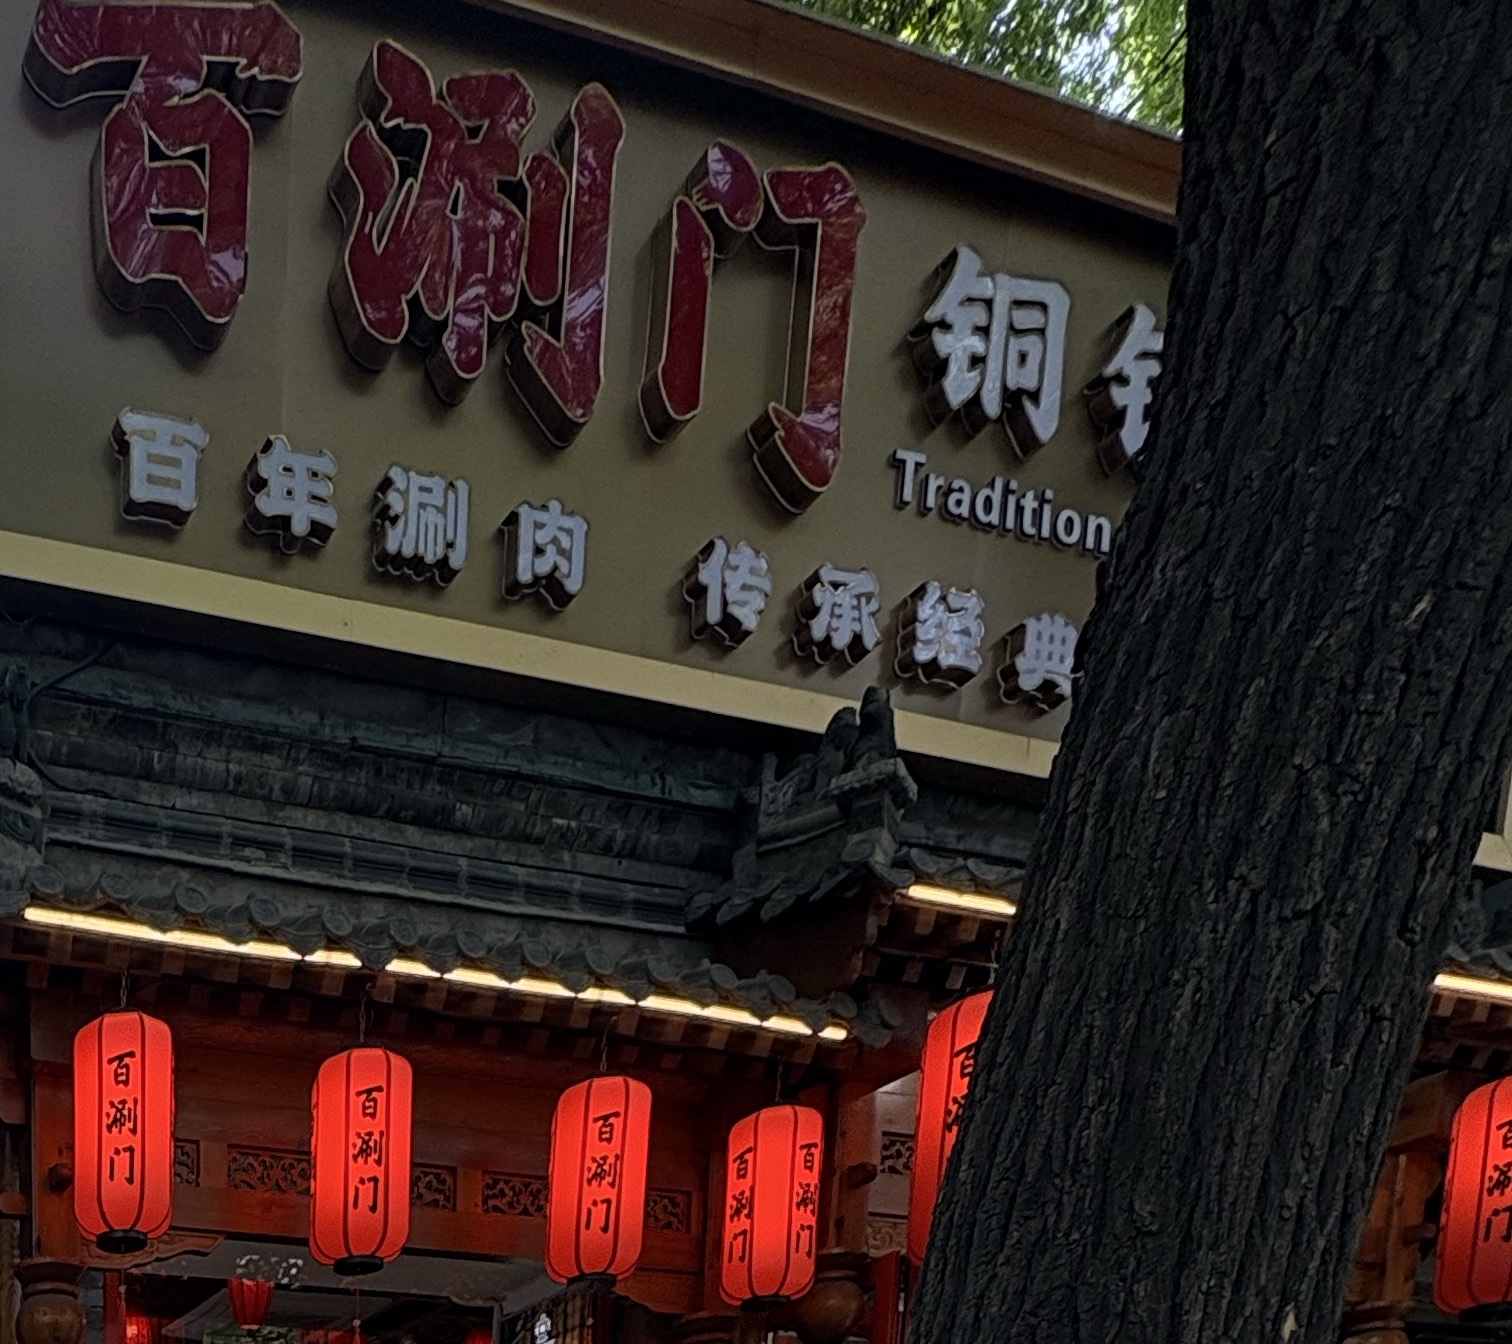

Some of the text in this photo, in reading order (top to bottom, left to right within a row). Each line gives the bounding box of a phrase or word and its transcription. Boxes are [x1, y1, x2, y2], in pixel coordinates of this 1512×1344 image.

[24, 0, 867, 512] 百涮门
[118, 406, 1082, 708] 百年涮肉 传承经典
[105, 1049, 139, 1186] 百涮门
[351, 1084, 386, 1215] 百涮门
[585, 1110, 622, 1235] 百涮门
[726, 1146, 755, 1265] 百涮门
[794, 1141, 819, 1260] 百涮门
